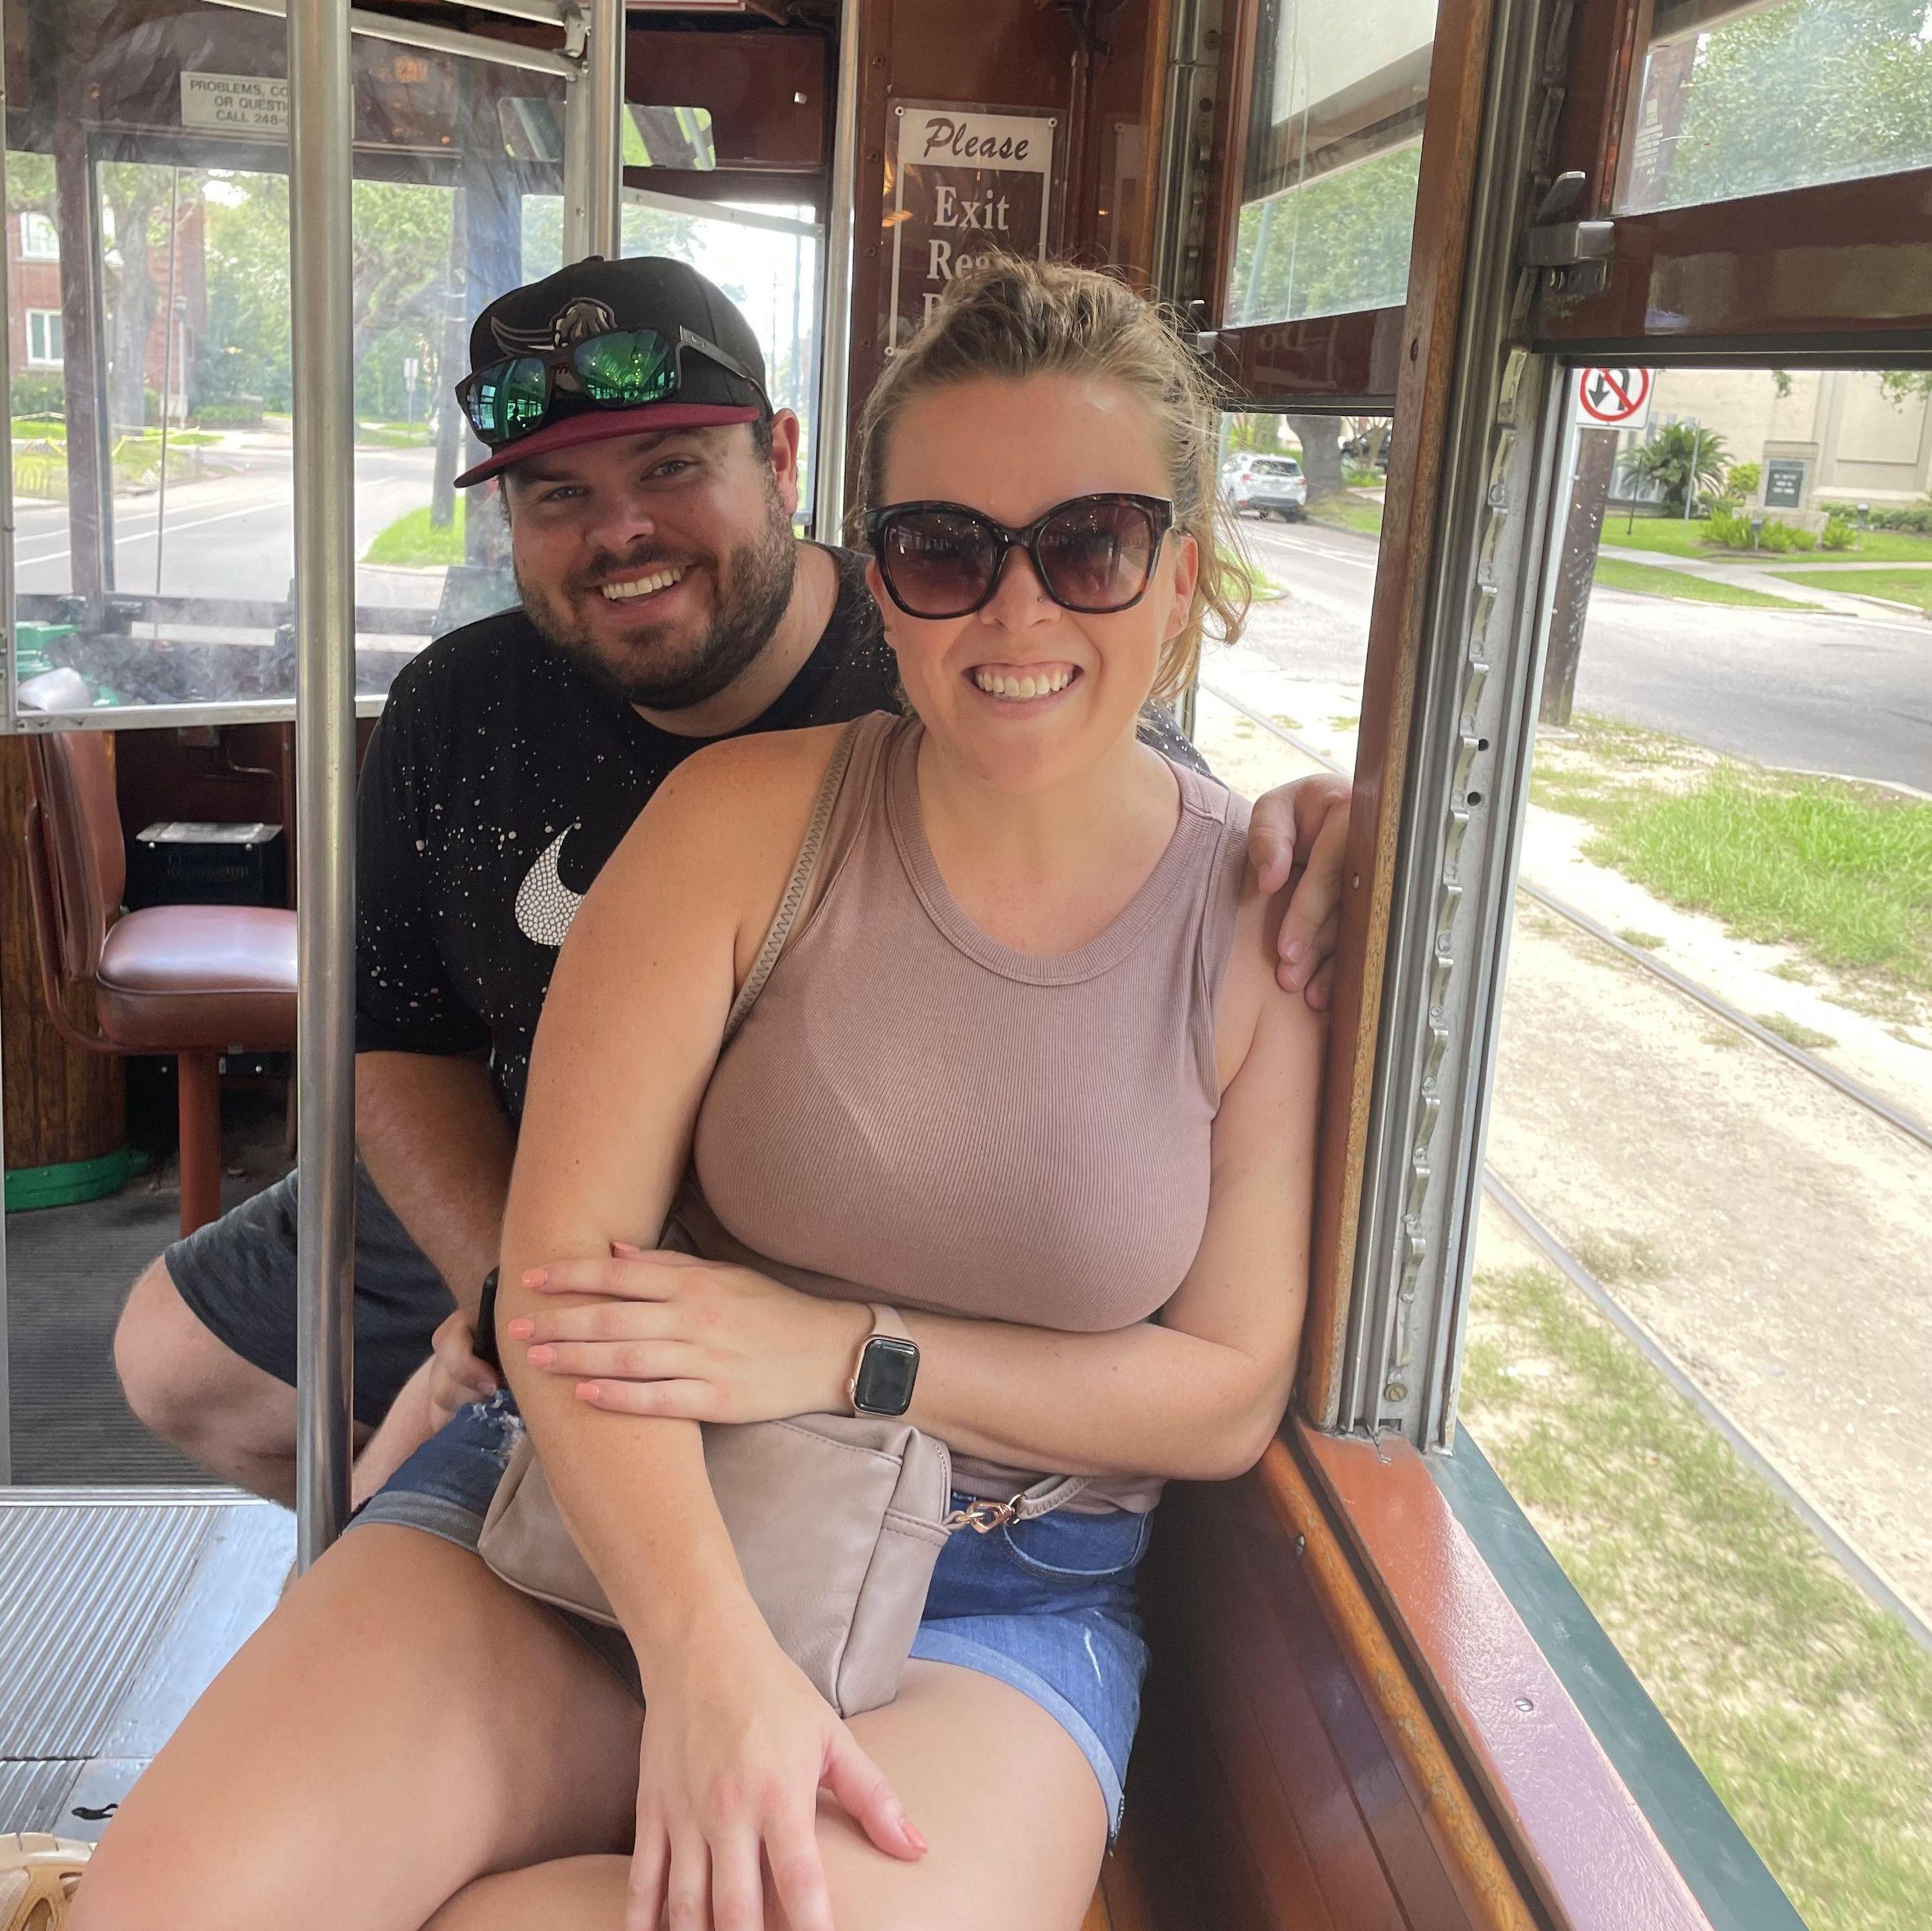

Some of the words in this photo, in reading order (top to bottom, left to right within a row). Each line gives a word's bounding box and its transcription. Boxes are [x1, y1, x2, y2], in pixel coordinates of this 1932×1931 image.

[190, 80, 264, 97] PROBLEMS,
[270, 86, 287, 97] CO
[214, 95, 233, 107] OR
[239, 97, 286, 111] QUESTI
[216, 110, 249, 123] CALL
[254, 113, 285, 125] 248-
[923, 117, 1029, 161] Please
[933, 186, 1010, 231] Exit
